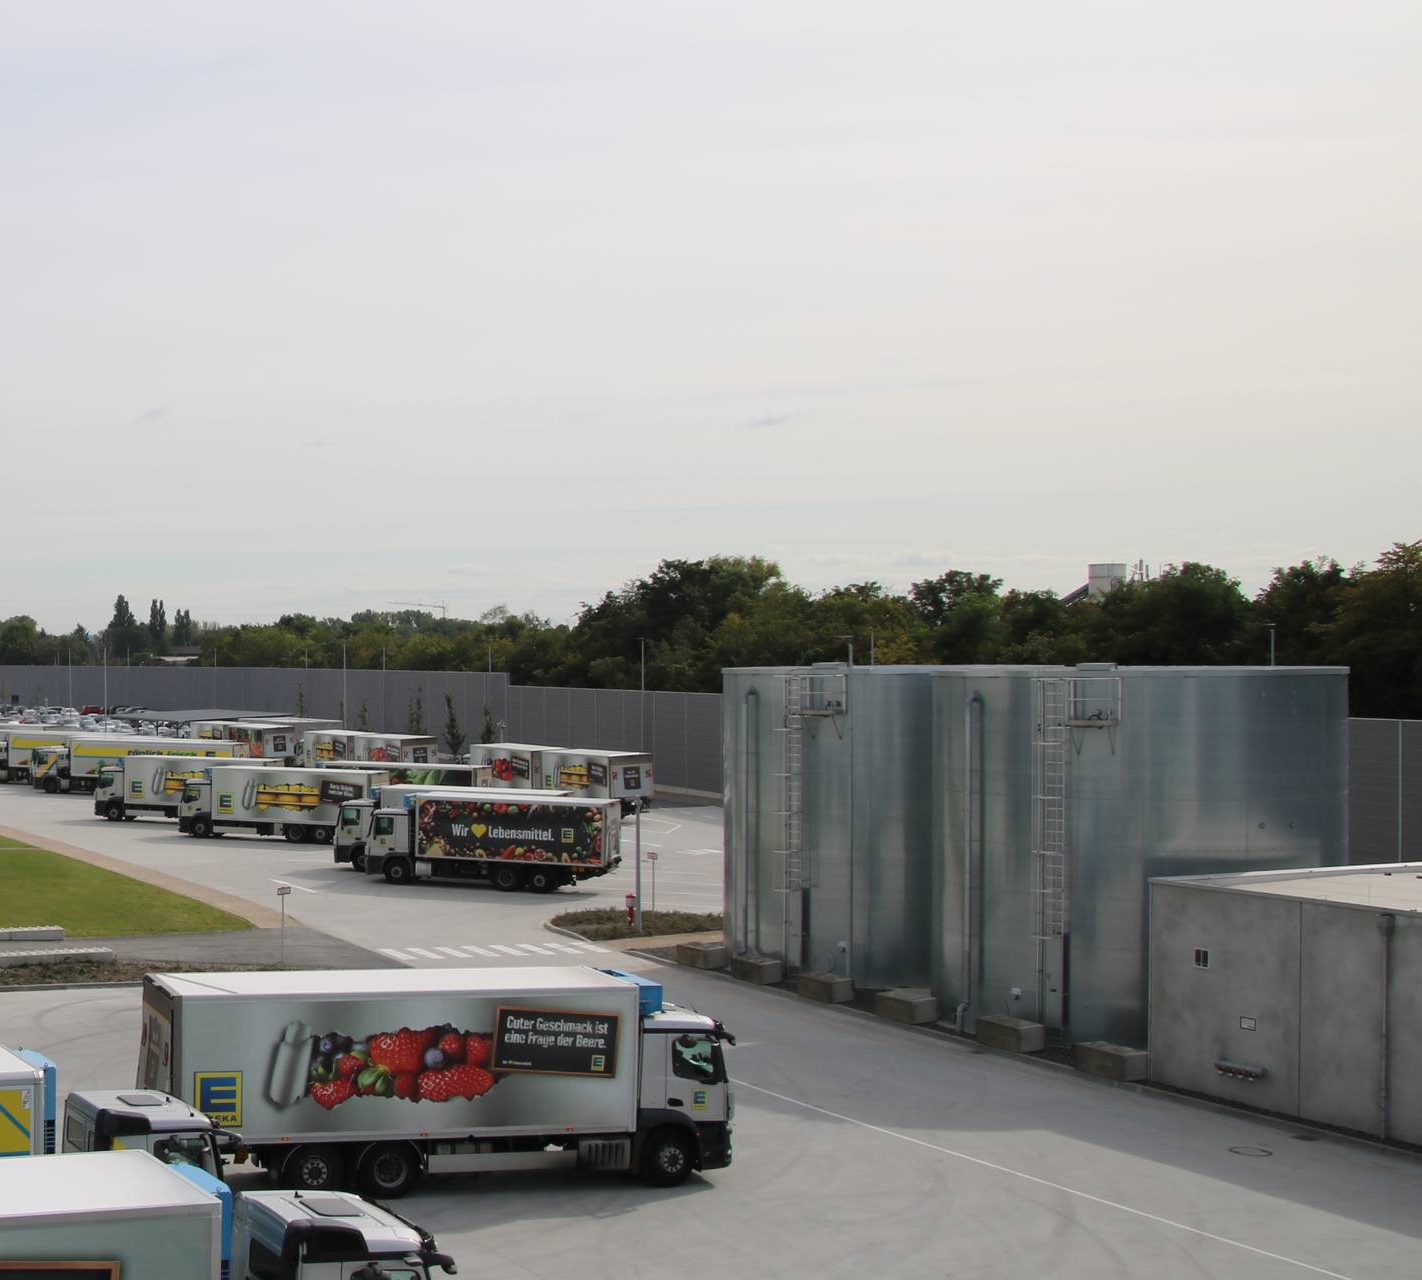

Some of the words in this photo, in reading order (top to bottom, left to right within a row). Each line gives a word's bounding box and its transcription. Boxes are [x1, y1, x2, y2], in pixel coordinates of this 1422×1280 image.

[219, 794, 232, 808] E
[452, 824, 469, 837] Wir
[488, 825, 555, 841] Lebensmittel.
[506, 1016, 534, 1030] Guter
[536, 1018, 592, 1033] Geschmack
[595, 1021, 609, 1035] ist
[504, 1031, 526, 1043] eine
[527, 1032, 555, 1048] Frage
[557, 1034, 574, 1046] der
[576, 1034, 607, 1048] Beere.
[200, 1077, 237, 1113] E
[693, 1091, 706, 1104] E
